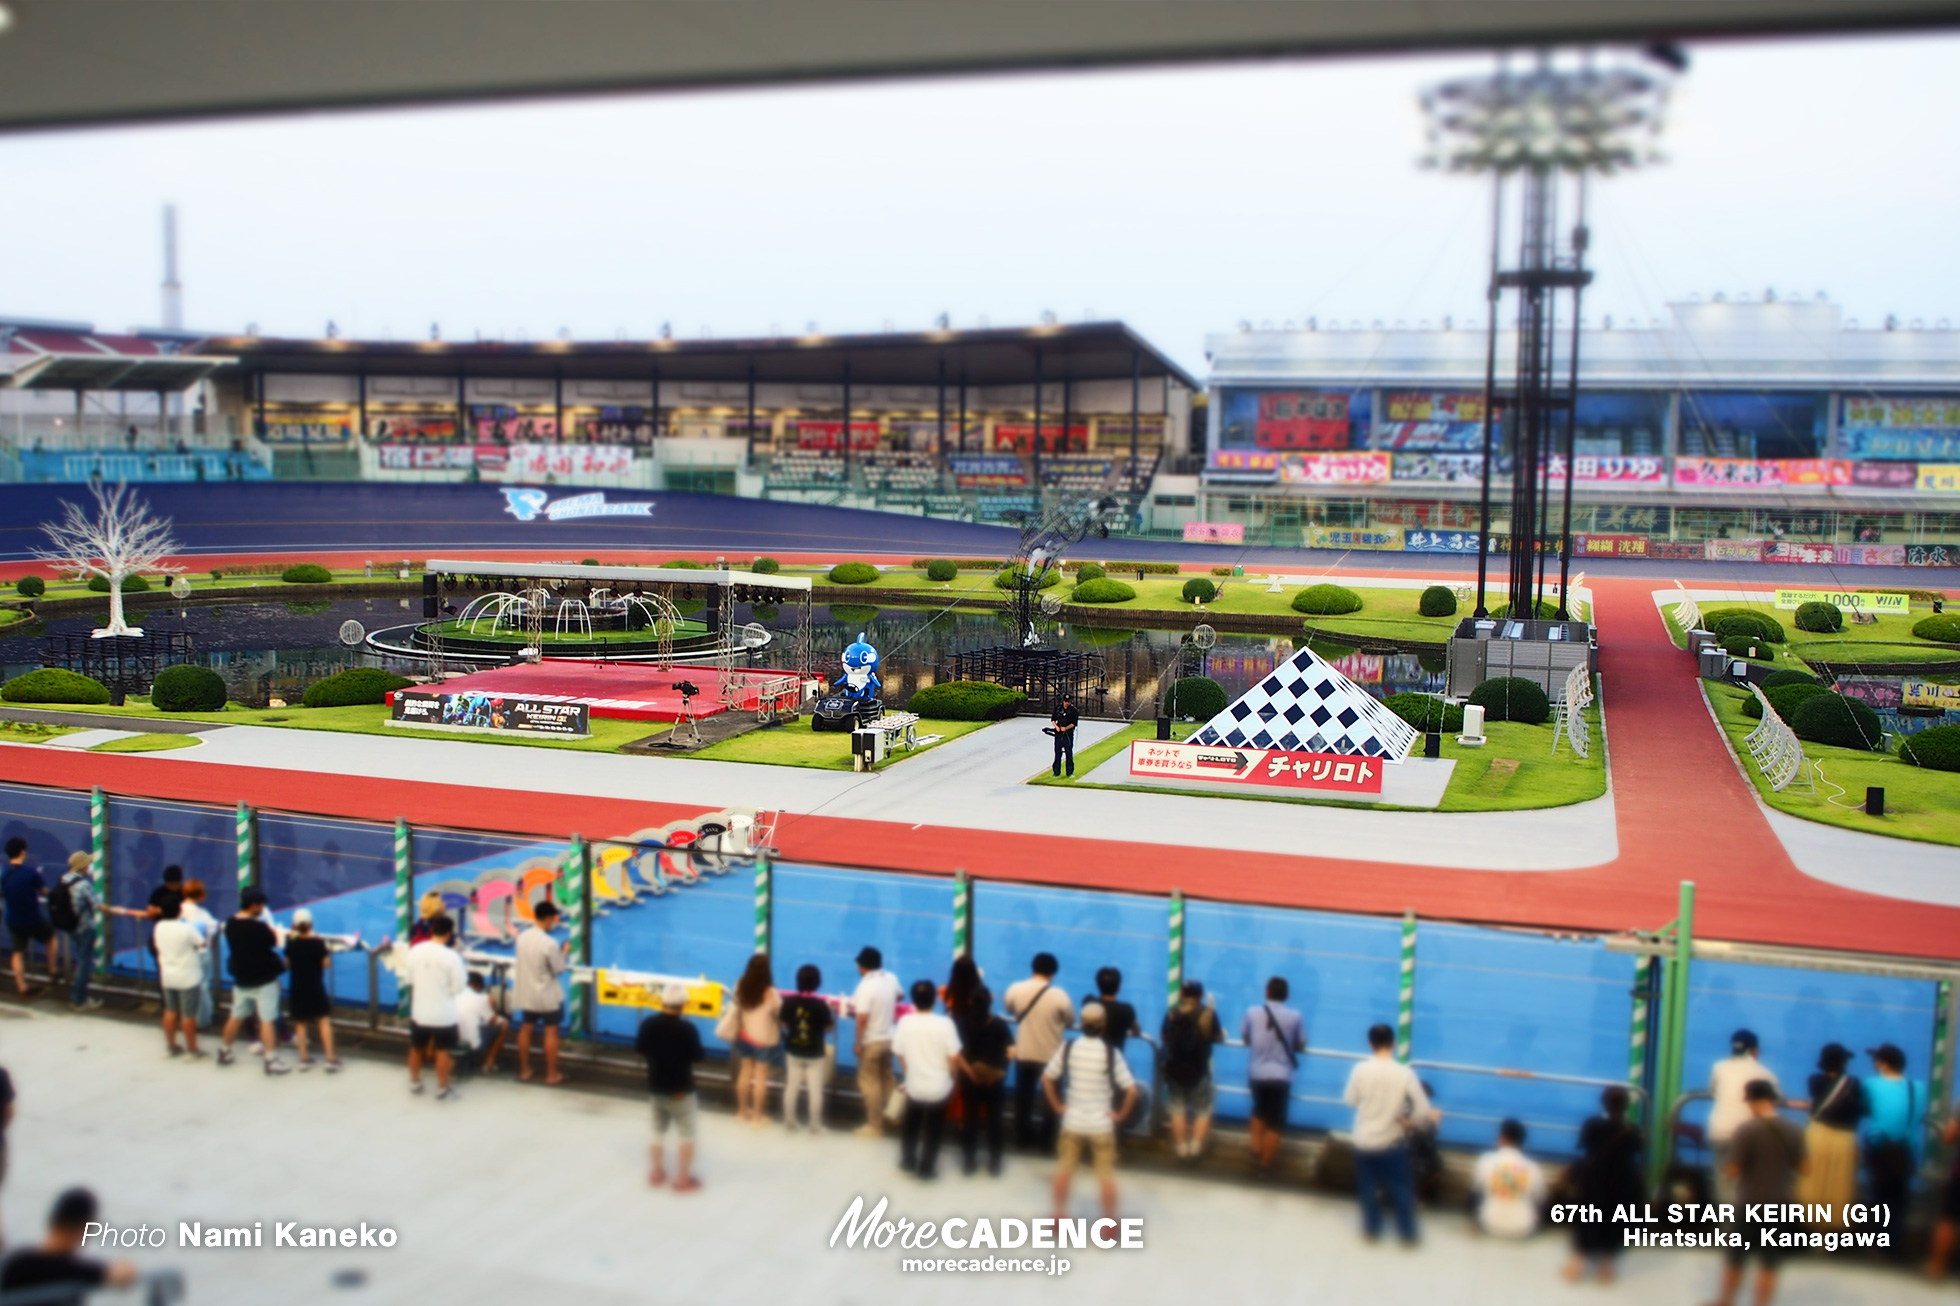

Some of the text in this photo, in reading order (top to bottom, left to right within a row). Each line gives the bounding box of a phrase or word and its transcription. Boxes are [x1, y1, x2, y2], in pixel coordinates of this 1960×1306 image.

[551, 504, 647, 519] SHONAN BANK
[1717, 546, 1736, 556] 石井
[1836, 548, 1904, 565] 山原さくら
[1908, 546, 1948, 565] 清水
[514, 703, 581, 717] ALL STAR
[526, 713, 556, 721] KEIRIN
[1148, 748, 1180, 758] ネットで
[1138, 758, 1192, 770] 車券を買うなら
[1267, 755, 1375, 785] チャリロト
